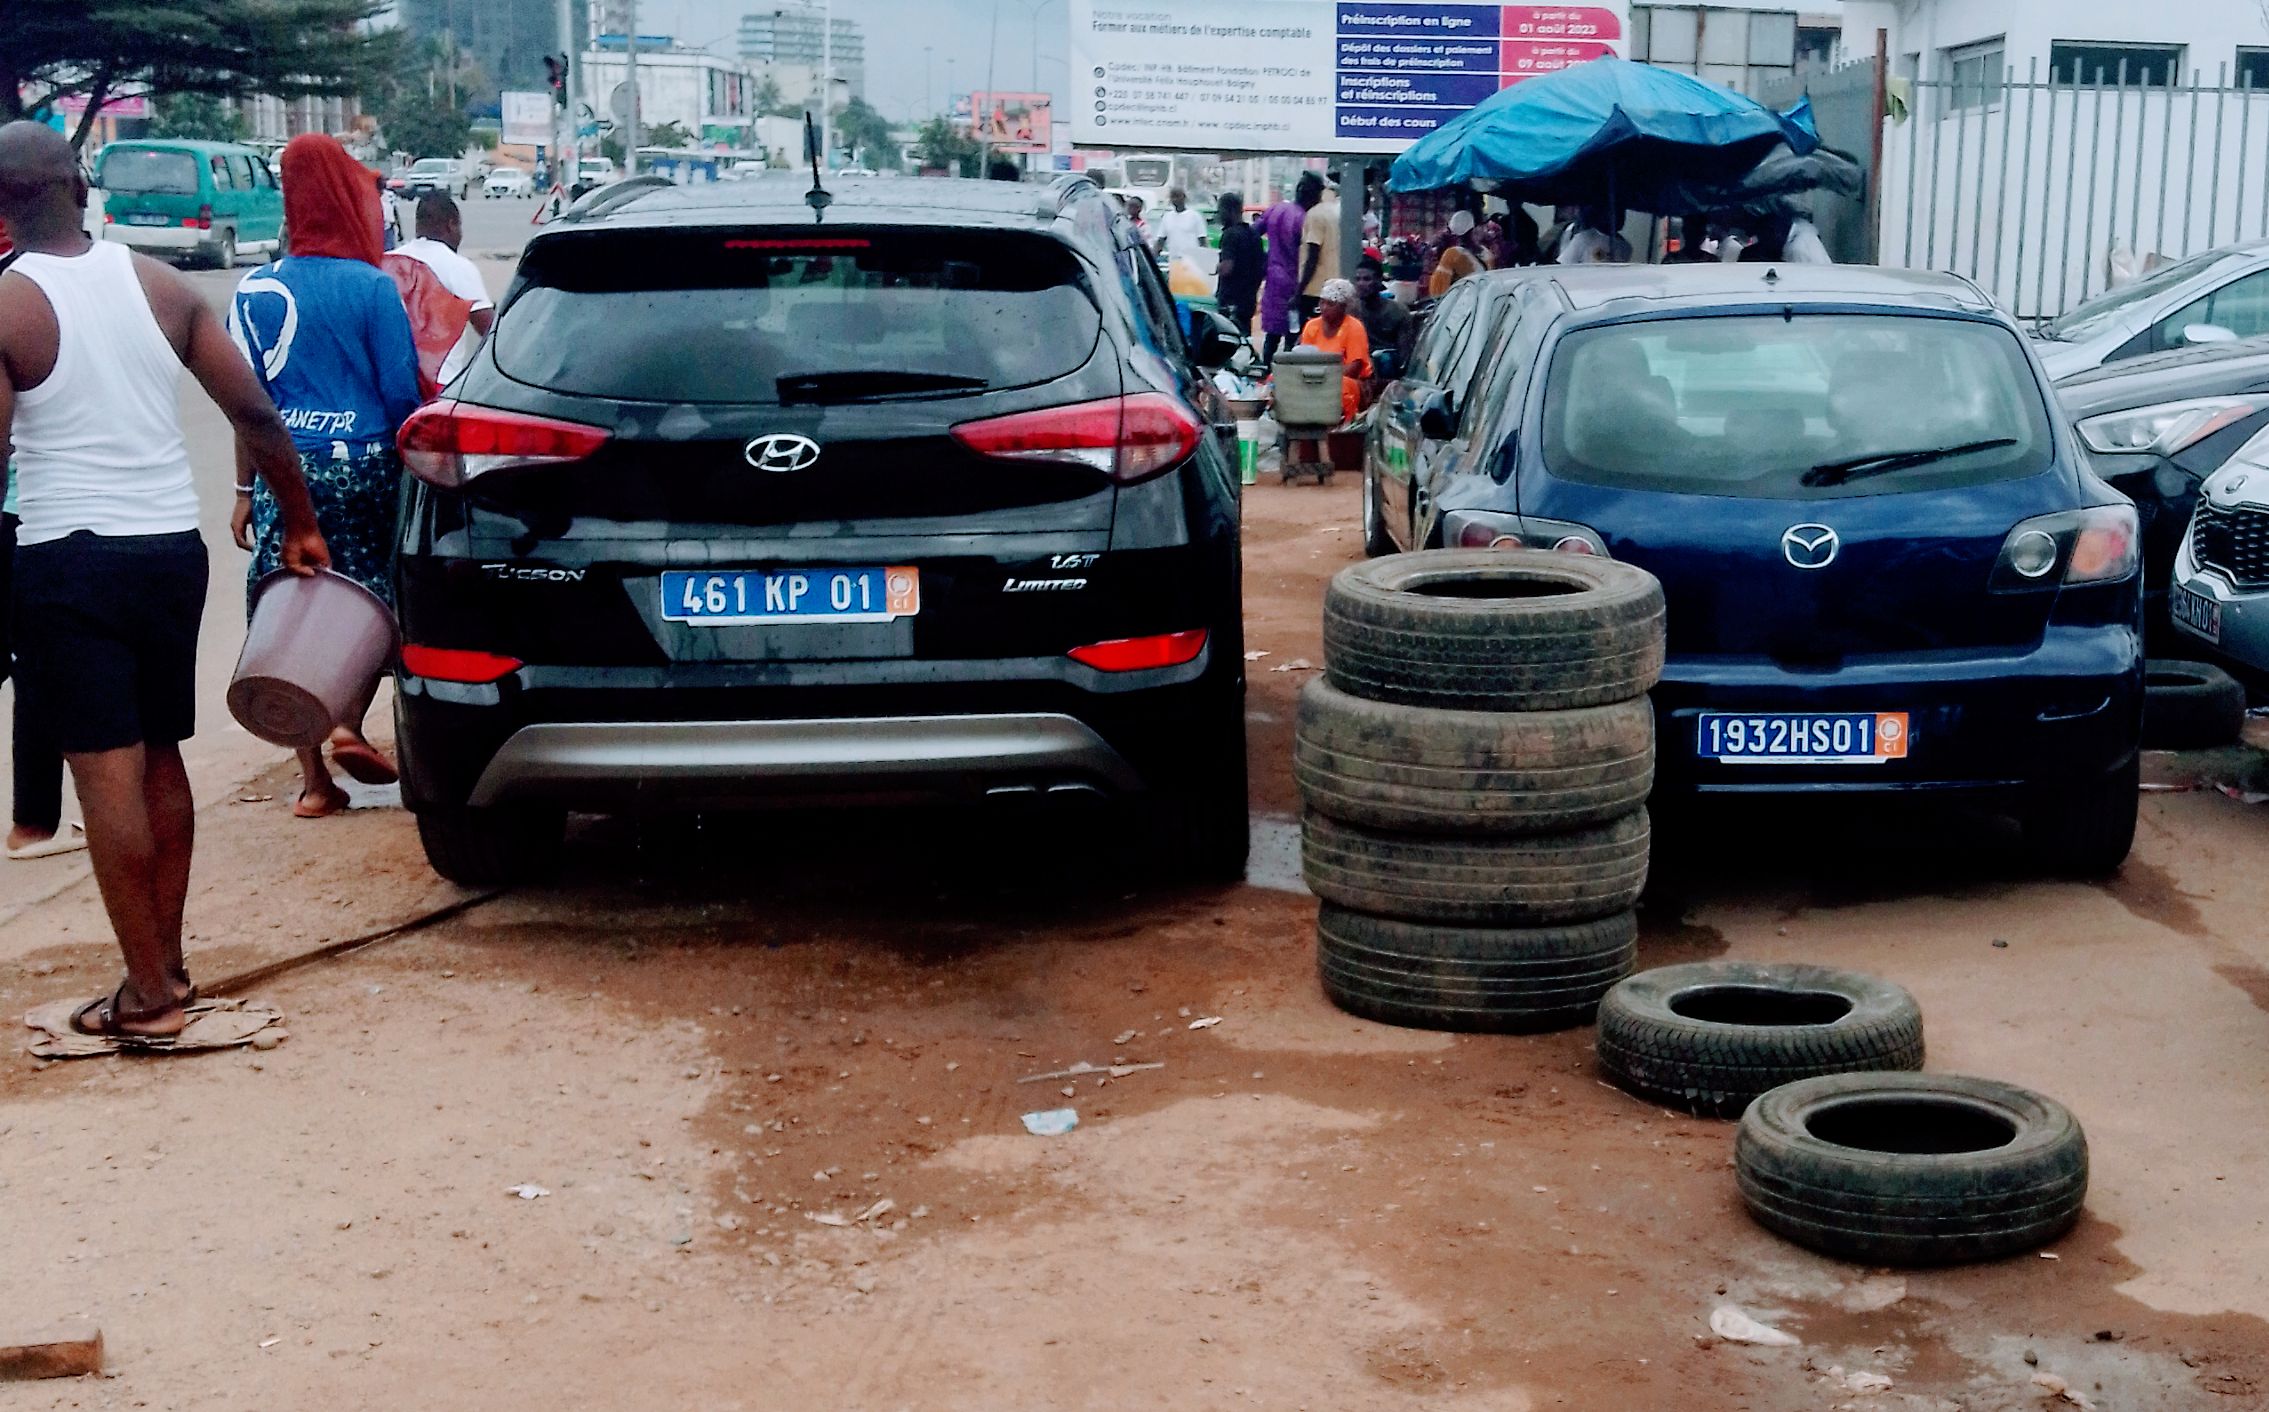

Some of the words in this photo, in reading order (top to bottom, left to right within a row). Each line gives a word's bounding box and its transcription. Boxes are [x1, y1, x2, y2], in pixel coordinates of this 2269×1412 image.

[1340, 13, 1421, 27] Préinscription
[1422, 18, 1439, 26] en
[1441, 16, 1472, 28] ligne
[1093, 20, 1127, 31] Former
[1130, 23, 1147, 32] aux
[1149, 23, 1188, 34] métiers
[1190, 24, 1201, 35] de
[1204, 24, 1256, 37] l'expertise
[1260, 26, 1311, 38] comptable
[1519, 23, 1533, 33] 01
[1537, 23, 1566, 34] août
[1567, 24, 1597, 35] 2023
[1340, 42, 1372, 54] Dépôt
[1372, 44, 1391, 53] des
[1392, 43, 1432, 54] dossiers
[1433, 45, 1444, 54] et
[1445, 45, 1493, 55] paiement
[1340, 56, 1359, 65] des
[1360, 56, 1381, 66] frais
[1382, 57, 1396, 66] de
[1397, 56, 1465, 68] préinscription
[1340, 75, 1411, 88] Inscriptions
[1340, 89, 1354, 100] et
[1355, 88, 1437, 102] réinscriptions
[1340, 115, 1378, 127] Début
[1379, 116, 1402, 127] des
[1403, 118, 1437, 128] cours
[481, 563, 585, 581] TUCSON
[683, 576, 747, 613] 461
[765, 575, 809, 612] KP
[830, 573, 870, 611] 01
[1709, 718, 1869, 753] 1932HS01
